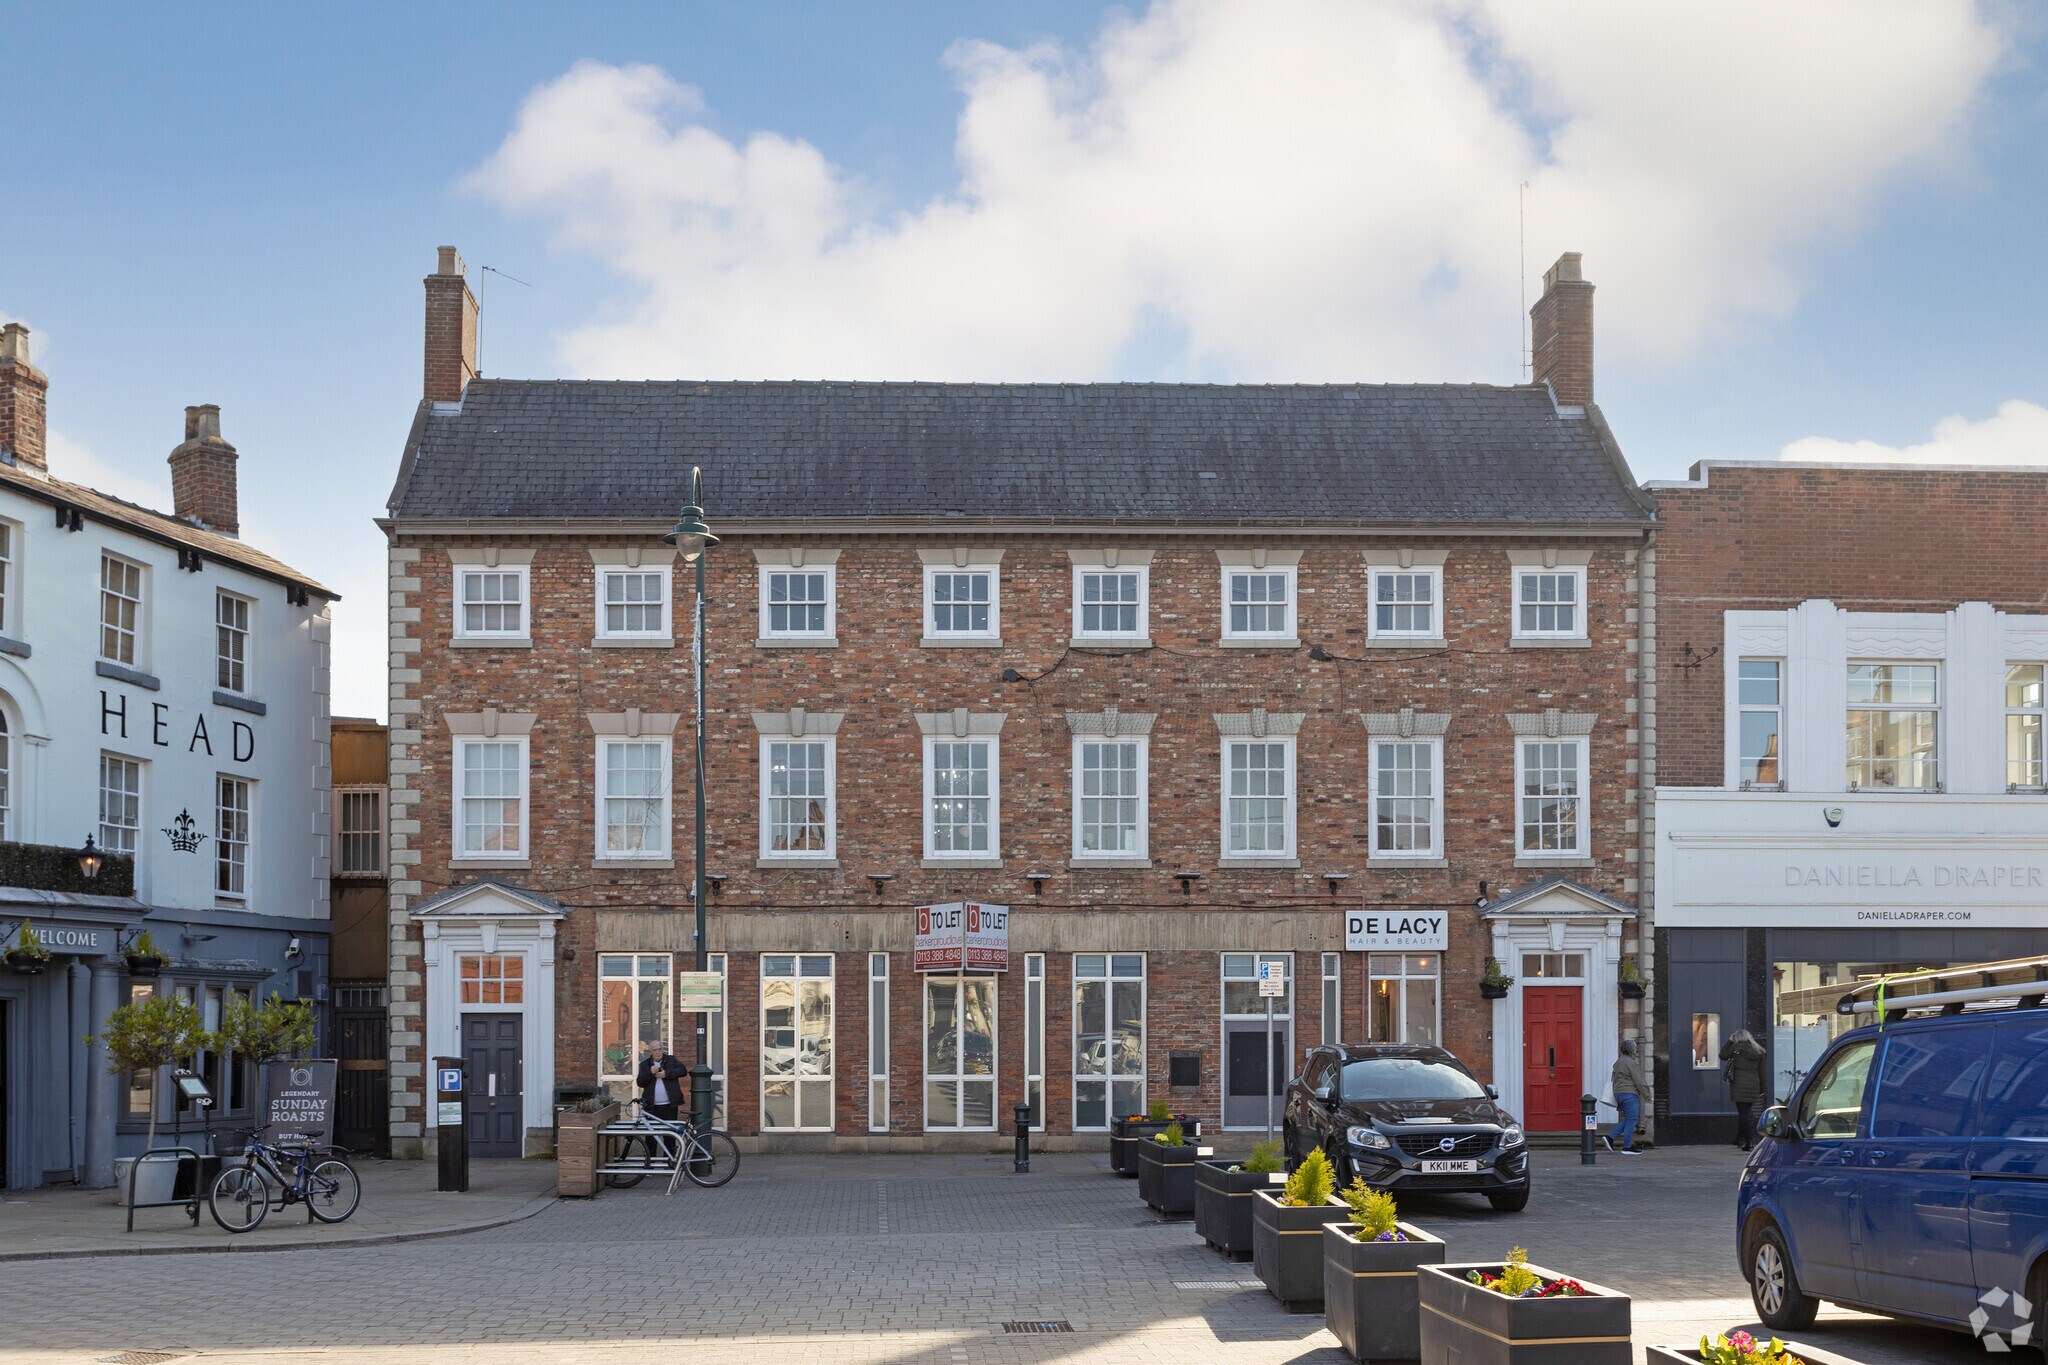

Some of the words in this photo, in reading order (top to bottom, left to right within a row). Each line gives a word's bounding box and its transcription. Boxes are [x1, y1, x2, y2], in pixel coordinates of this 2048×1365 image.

[100, 690, 254, 762] HEAD
[1785, 865, 1922, 887] DANIELLA
[1934, 865, 2043, 887] DRAPER
[931, 912, 943, 929] TO
[945, 910, 961, 928] LET
[981, 912, 991, 929] TO
[993, 912, 1007, 930] LET
[1857, 911, 1971, 921] DANIELLADRAPER.COM
[1349, 918, 1379, 934] DE
[1386, 918, 1442, 934] LACY
[916, 951, 931, 962] 0113
[931, 949, 944, 961] 388
[945, 948, 961, 960] 4848
[967, 949, 981, 960] 0113
[981, 949, 992, 961] 388
[992, 950, 1007, 962] 4848
[444, 1071, 459, 1089] P
[271, 1099, 328, 1110] SUNDAY
[271, 1111, 325, 1122] ROASTS
[1430, 1161, 1448, 1171] KK11
[1450, 1161, 1469, 1171] MME
